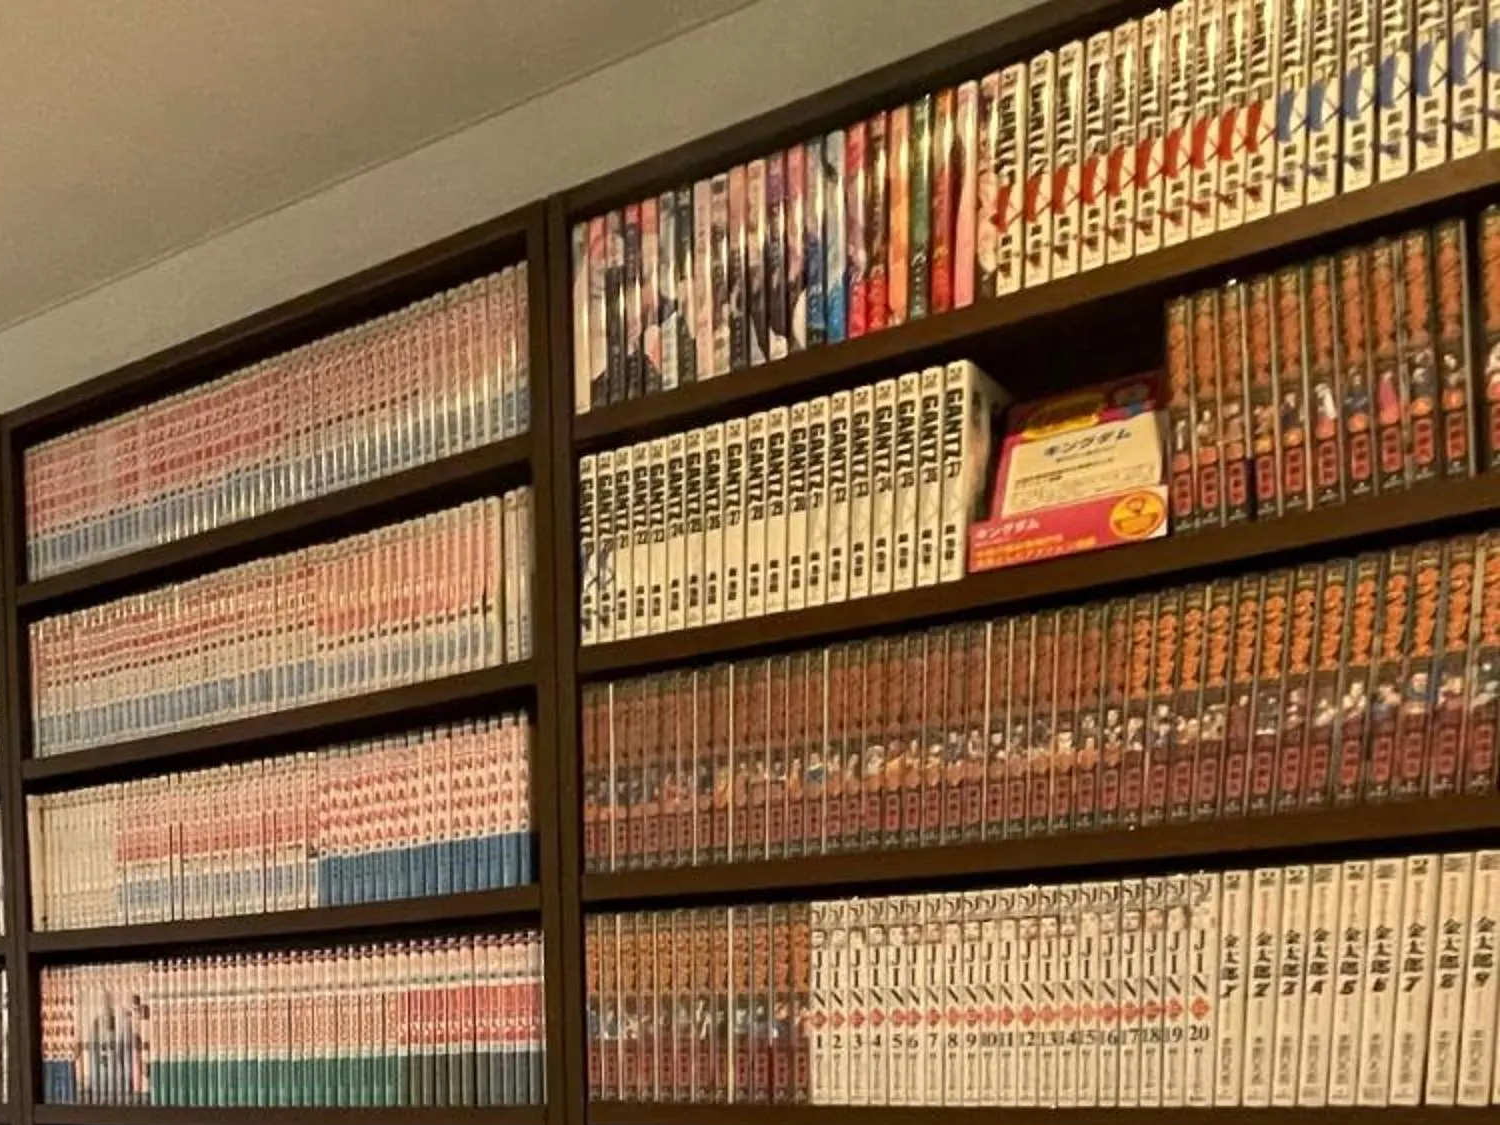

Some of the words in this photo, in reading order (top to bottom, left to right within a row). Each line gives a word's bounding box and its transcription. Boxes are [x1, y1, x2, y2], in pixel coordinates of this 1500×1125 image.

[874, 405, 893, 474] GANTZ
[896, 400, 915, 469] GANTZ
[920, 395, 938, 463] GANTZ
[943, 388, 963, 458] GANTZ
[789, 428, 806, 492] GANTZ
[809, 423, 824, 489] GANTZ
[830, 417, 847, 483] GANTZ
[852, 411, 870, 479] GANTZ
[705, 448, 721, 511] GANTZ
[725, 443, 742, 506] GANTZ
[748, 437, 765, 502] GANTZ
[769, 432, 784, 497] GANTZ
[615, 470, 629, 531] GANTZ
[633, 466, 647, 528] GANTZ
[650, 464, 665, 526] GANTZ
[668, 458, 683, 519] GANTZ
[686, 453, 701, 515] GANTZ
[816, 1035, 822, 1048] 1
[833, 1036, 842, 1048] 2
[853, 1034, 862, 1048] 3
[872, 1034, 881, 1047] 4
[893, 1033, 904, 1048] 5
[908, 1034, 919, 1048] 6
[929, 1033, 938, 1047] 7
[948, 1034, 958, 1047] 8
[967, 1033, 977, 1047] 9
[1041, 1032, 1057, 1046] 13
[1060, 1031, 1077, 1045] 14
[1080, 1031, 1094, 1044] 15
[1100, 1031, 1119, 1044] 16
[1122, 1029, 1140, 1044] 17
[1142, 1028, 1161, 1043] 18
[1164, 1027, 1182, 1041] 19
[1189, 1026, 1209, 1041] 20
